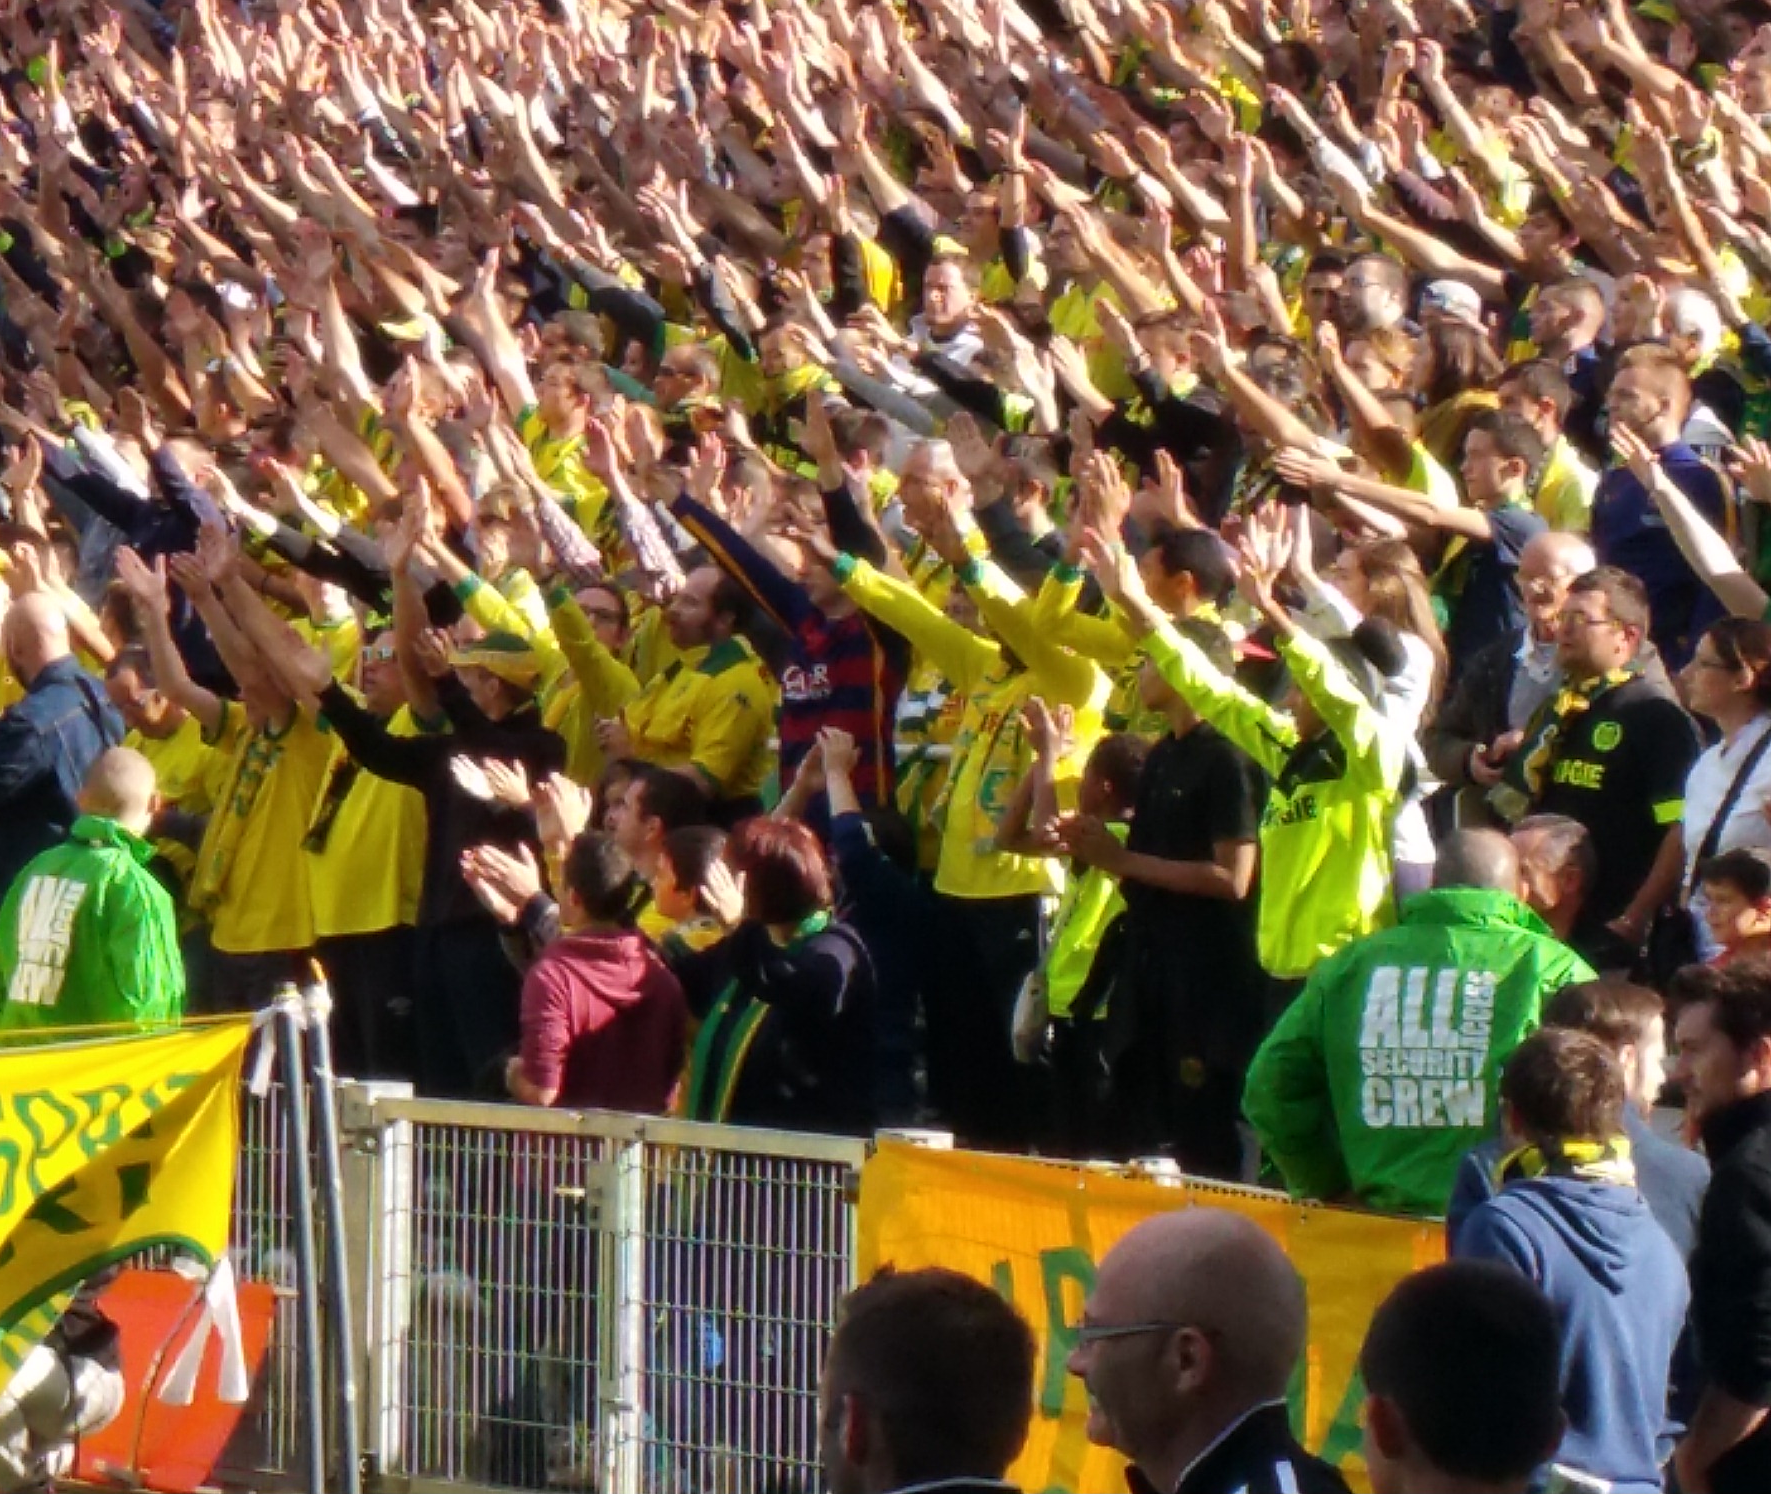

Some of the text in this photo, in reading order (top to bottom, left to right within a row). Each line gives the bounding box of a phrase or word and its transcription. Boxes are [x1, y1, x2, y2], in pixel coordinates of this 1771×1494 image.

[1360, 966, 1459, 1048] ALL
[1360, 1048, 1488, 1078] SECURITY
[1361, 1076, 1486, 1128] CREW
